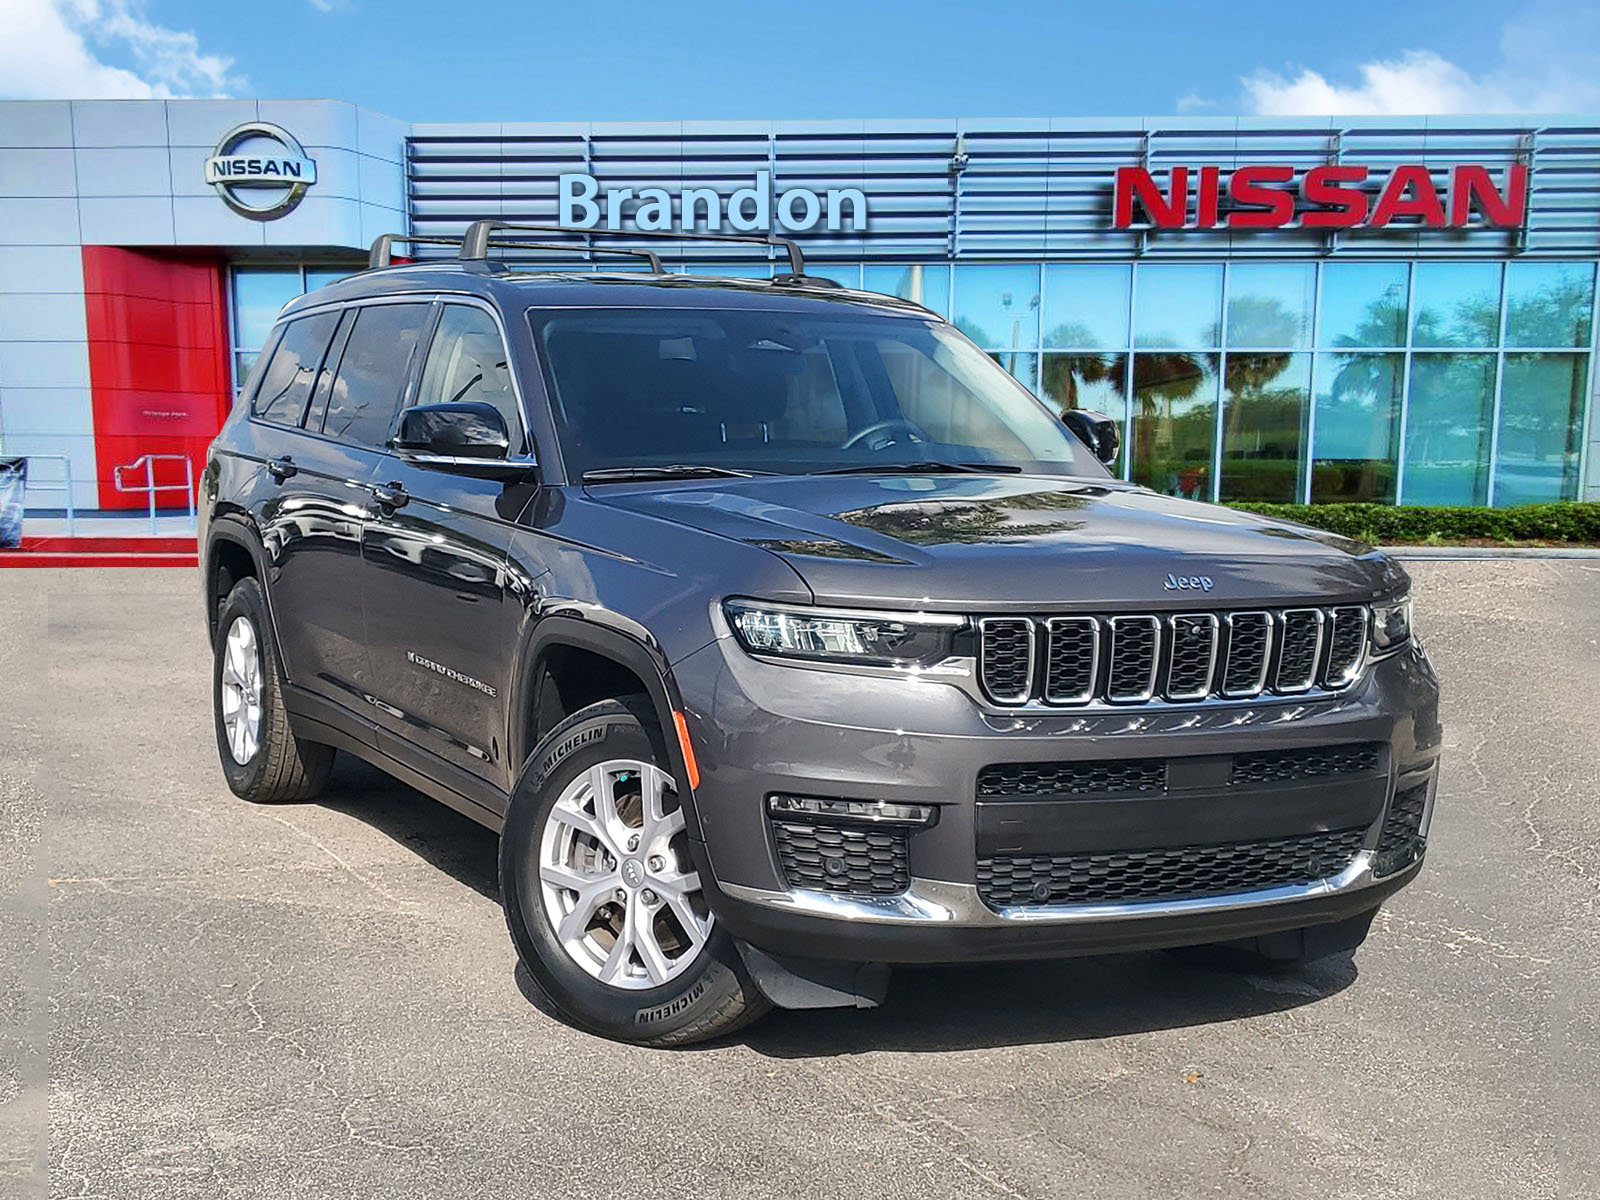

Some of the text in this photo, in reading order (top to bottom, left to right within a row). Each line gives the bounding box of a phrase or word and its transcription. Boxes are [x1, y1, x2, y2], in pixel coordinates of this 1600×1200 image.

[214, 160, 301, 177] NISSAN
[559, 170, 867, 231] Brandon
[1113, 165, 1529, 229] NISSAN
[1163, 573, 1214, 592] Jeep
[542, 728, 603, 772] MICHELIN
[639, 982, 705, 1024] MICHELIN
